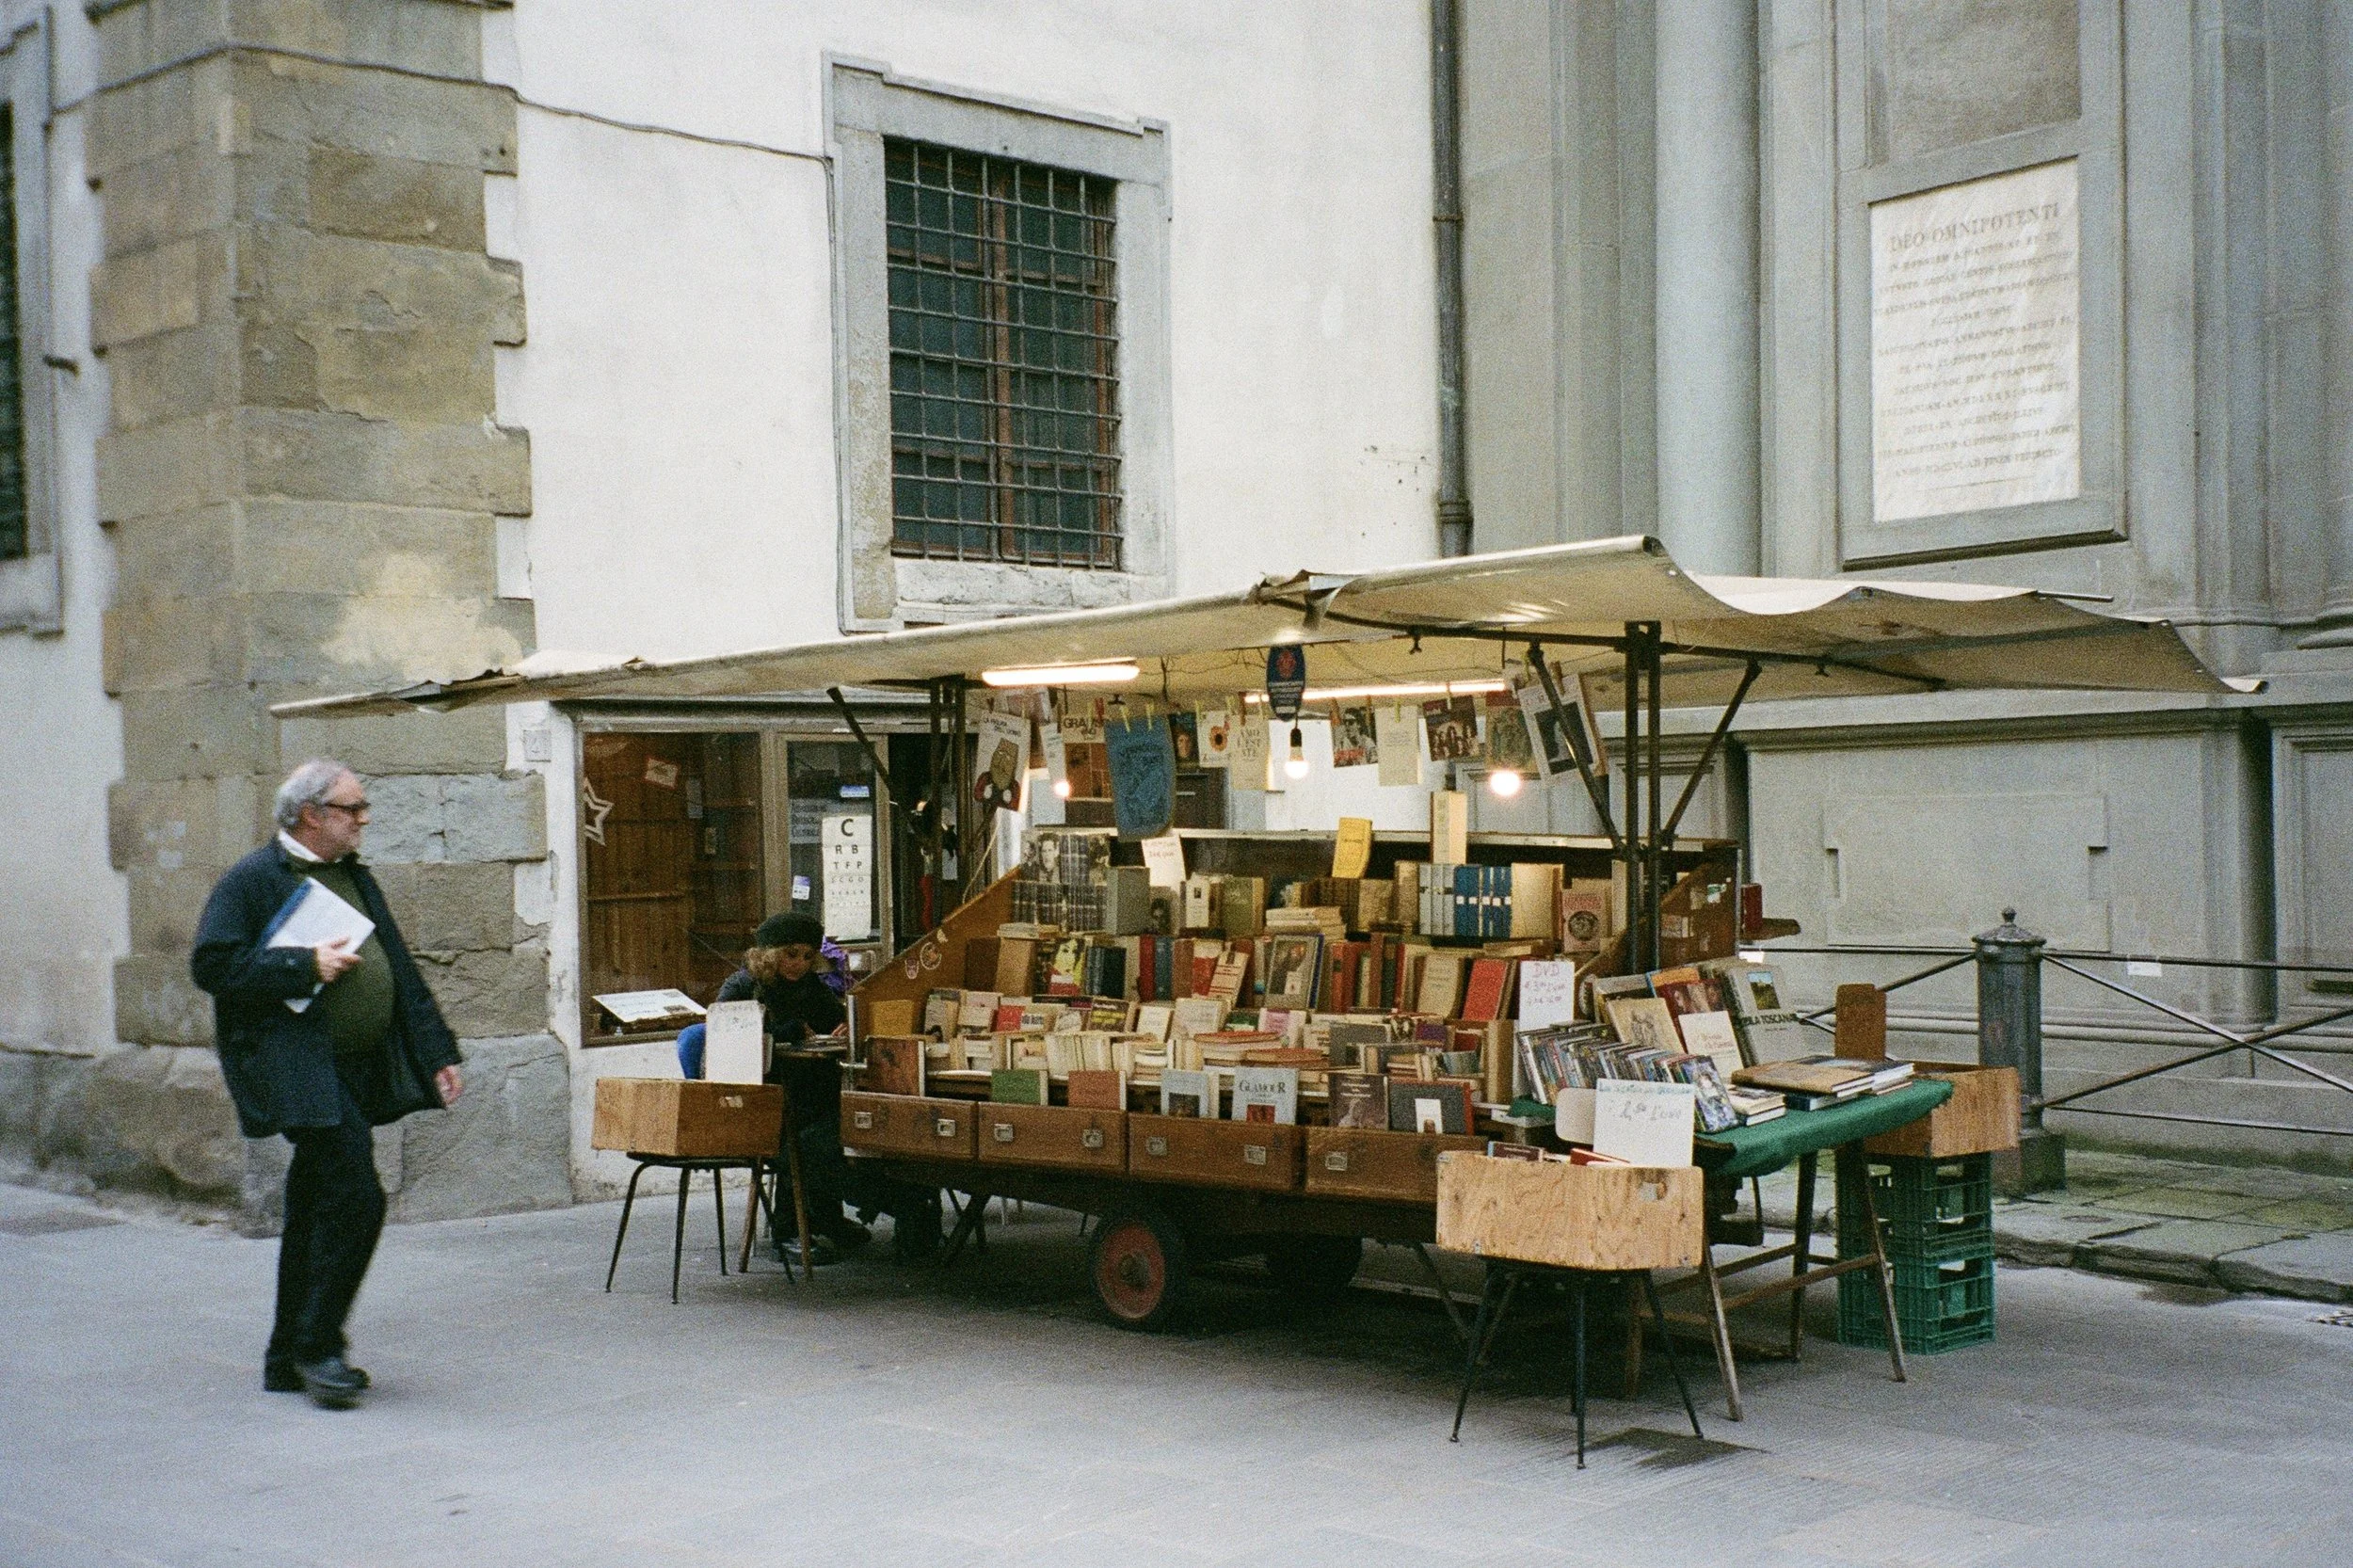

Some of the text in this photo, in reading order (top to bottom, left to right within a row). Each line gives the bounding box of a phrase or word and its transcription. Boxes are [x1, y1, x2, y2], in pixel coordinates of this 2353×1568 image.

[840, 818, 855, 838] C
[835, 844, 859, 856] R B
[1532, 962, 1561, 979] DVD
